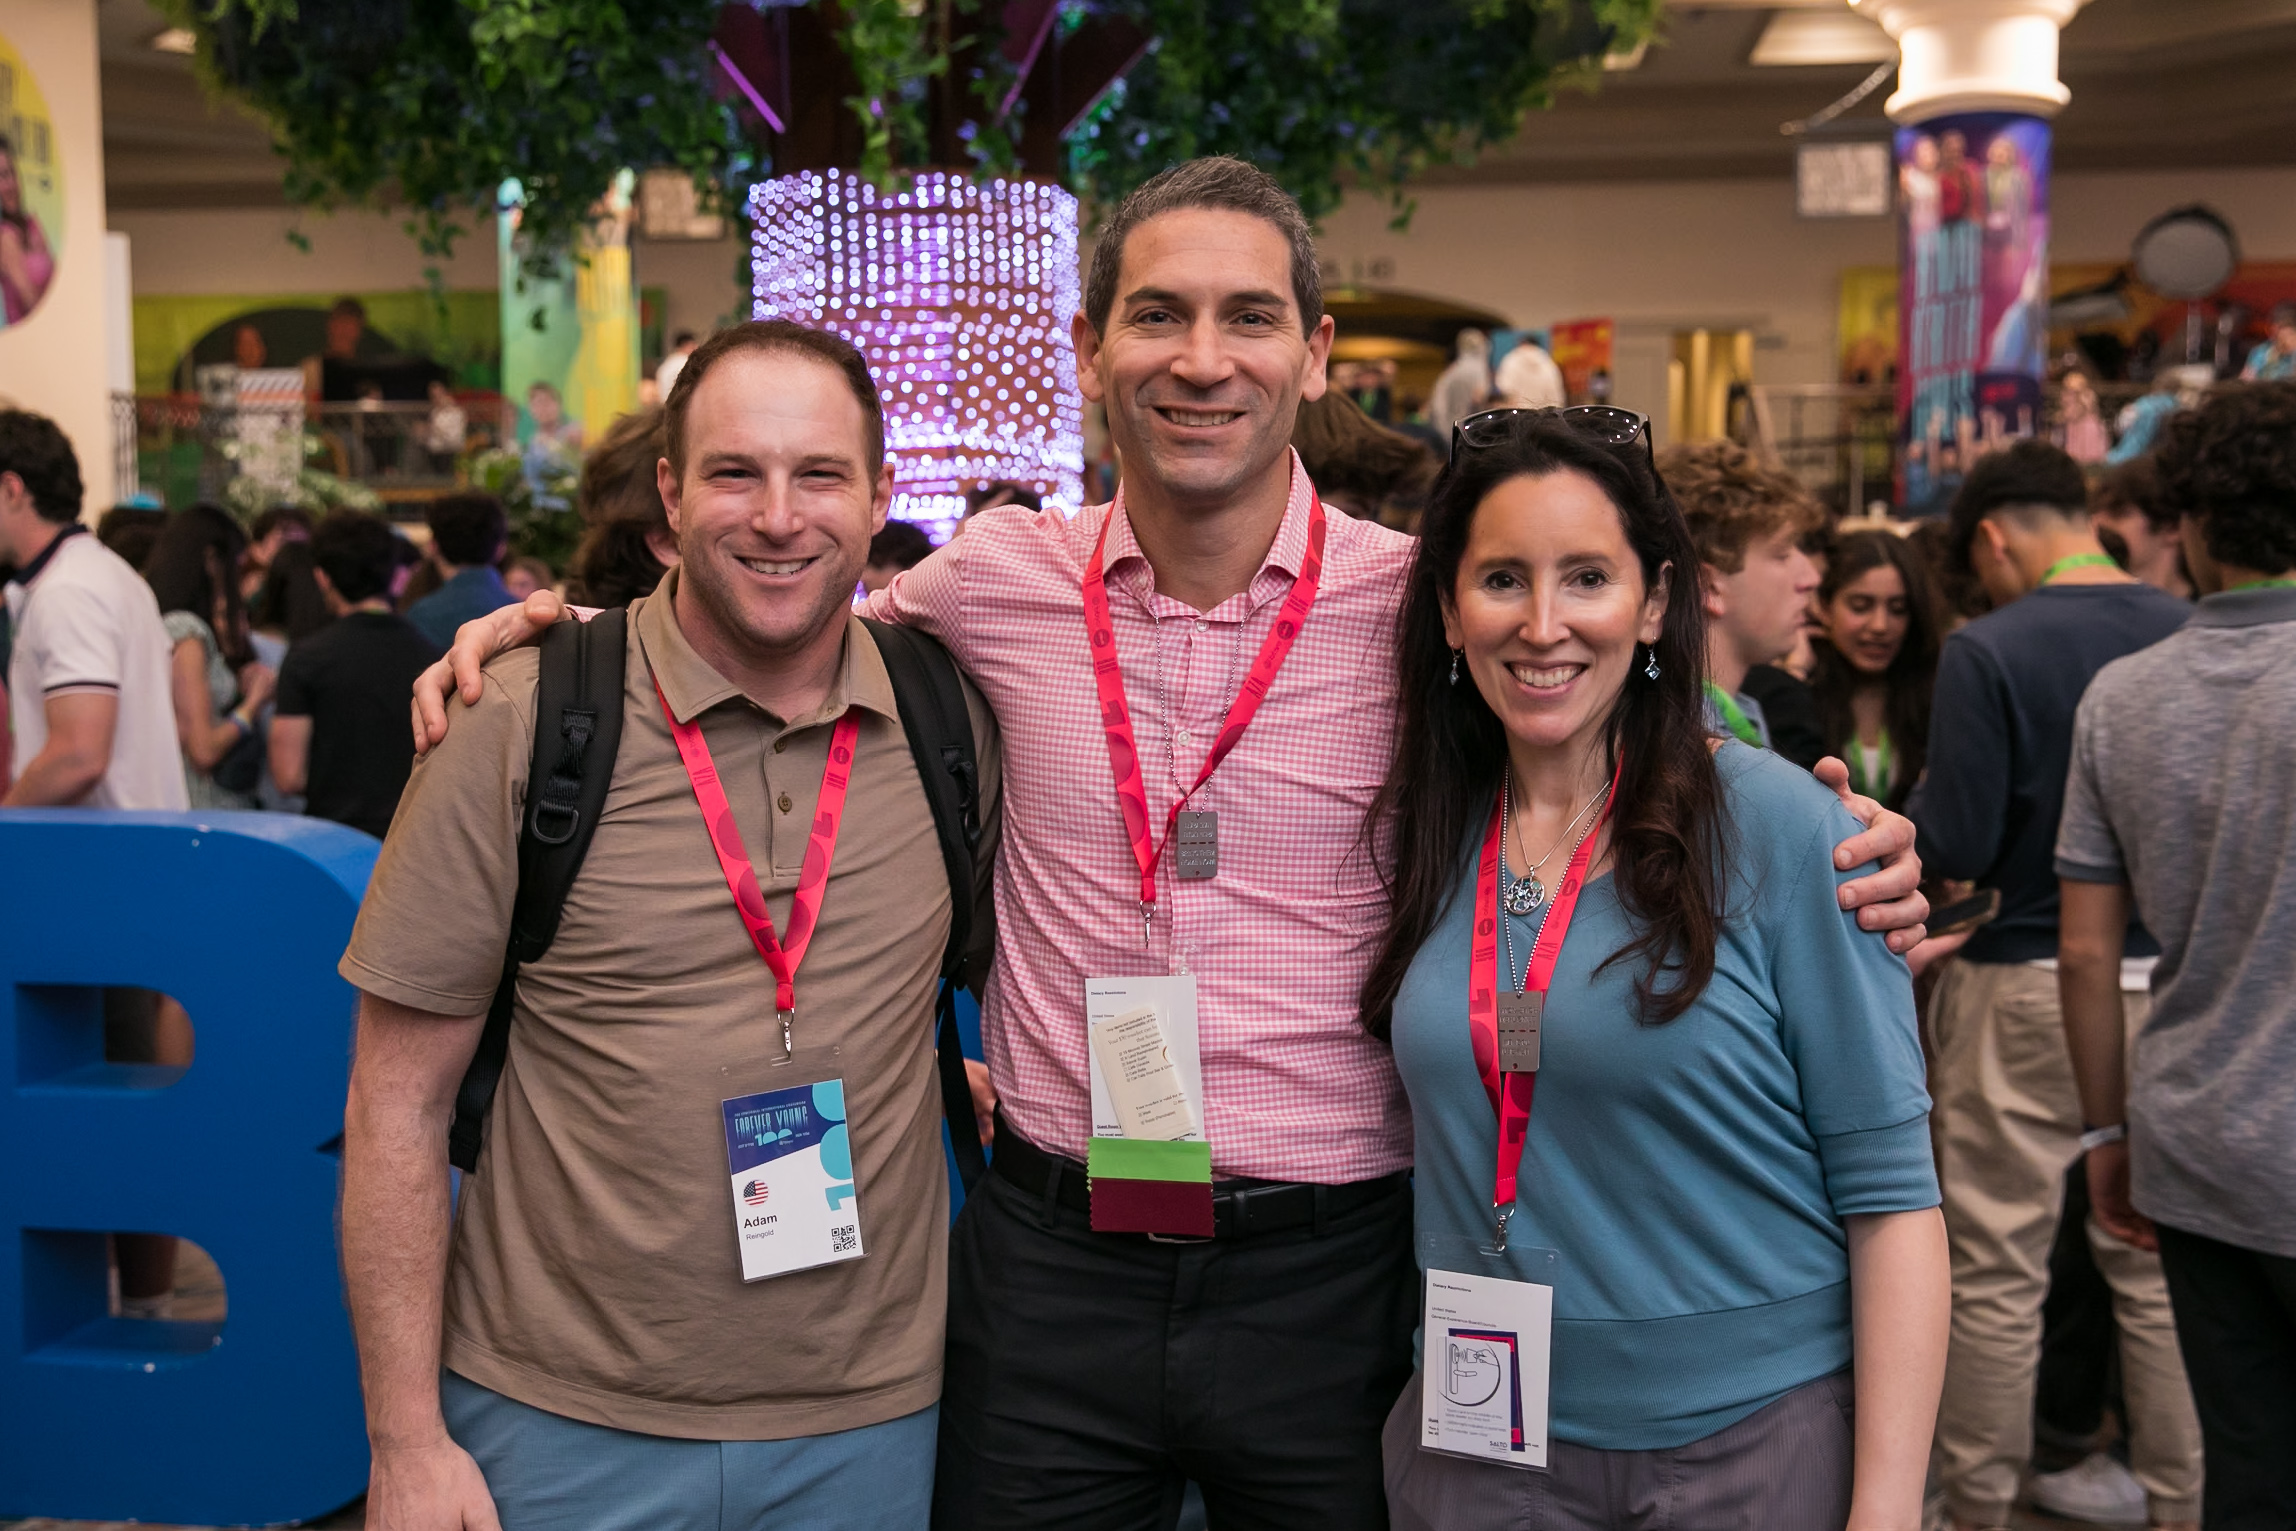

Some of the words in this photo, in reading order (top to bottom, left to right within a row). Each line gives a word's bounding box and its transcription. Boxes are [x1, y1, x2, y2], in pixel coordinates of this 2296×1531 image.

[775, 1106, 808, 1127] YOUNG
[743, 1213, 778, 1229] Adam
[746, 1229, 775, 1241] Reingold
